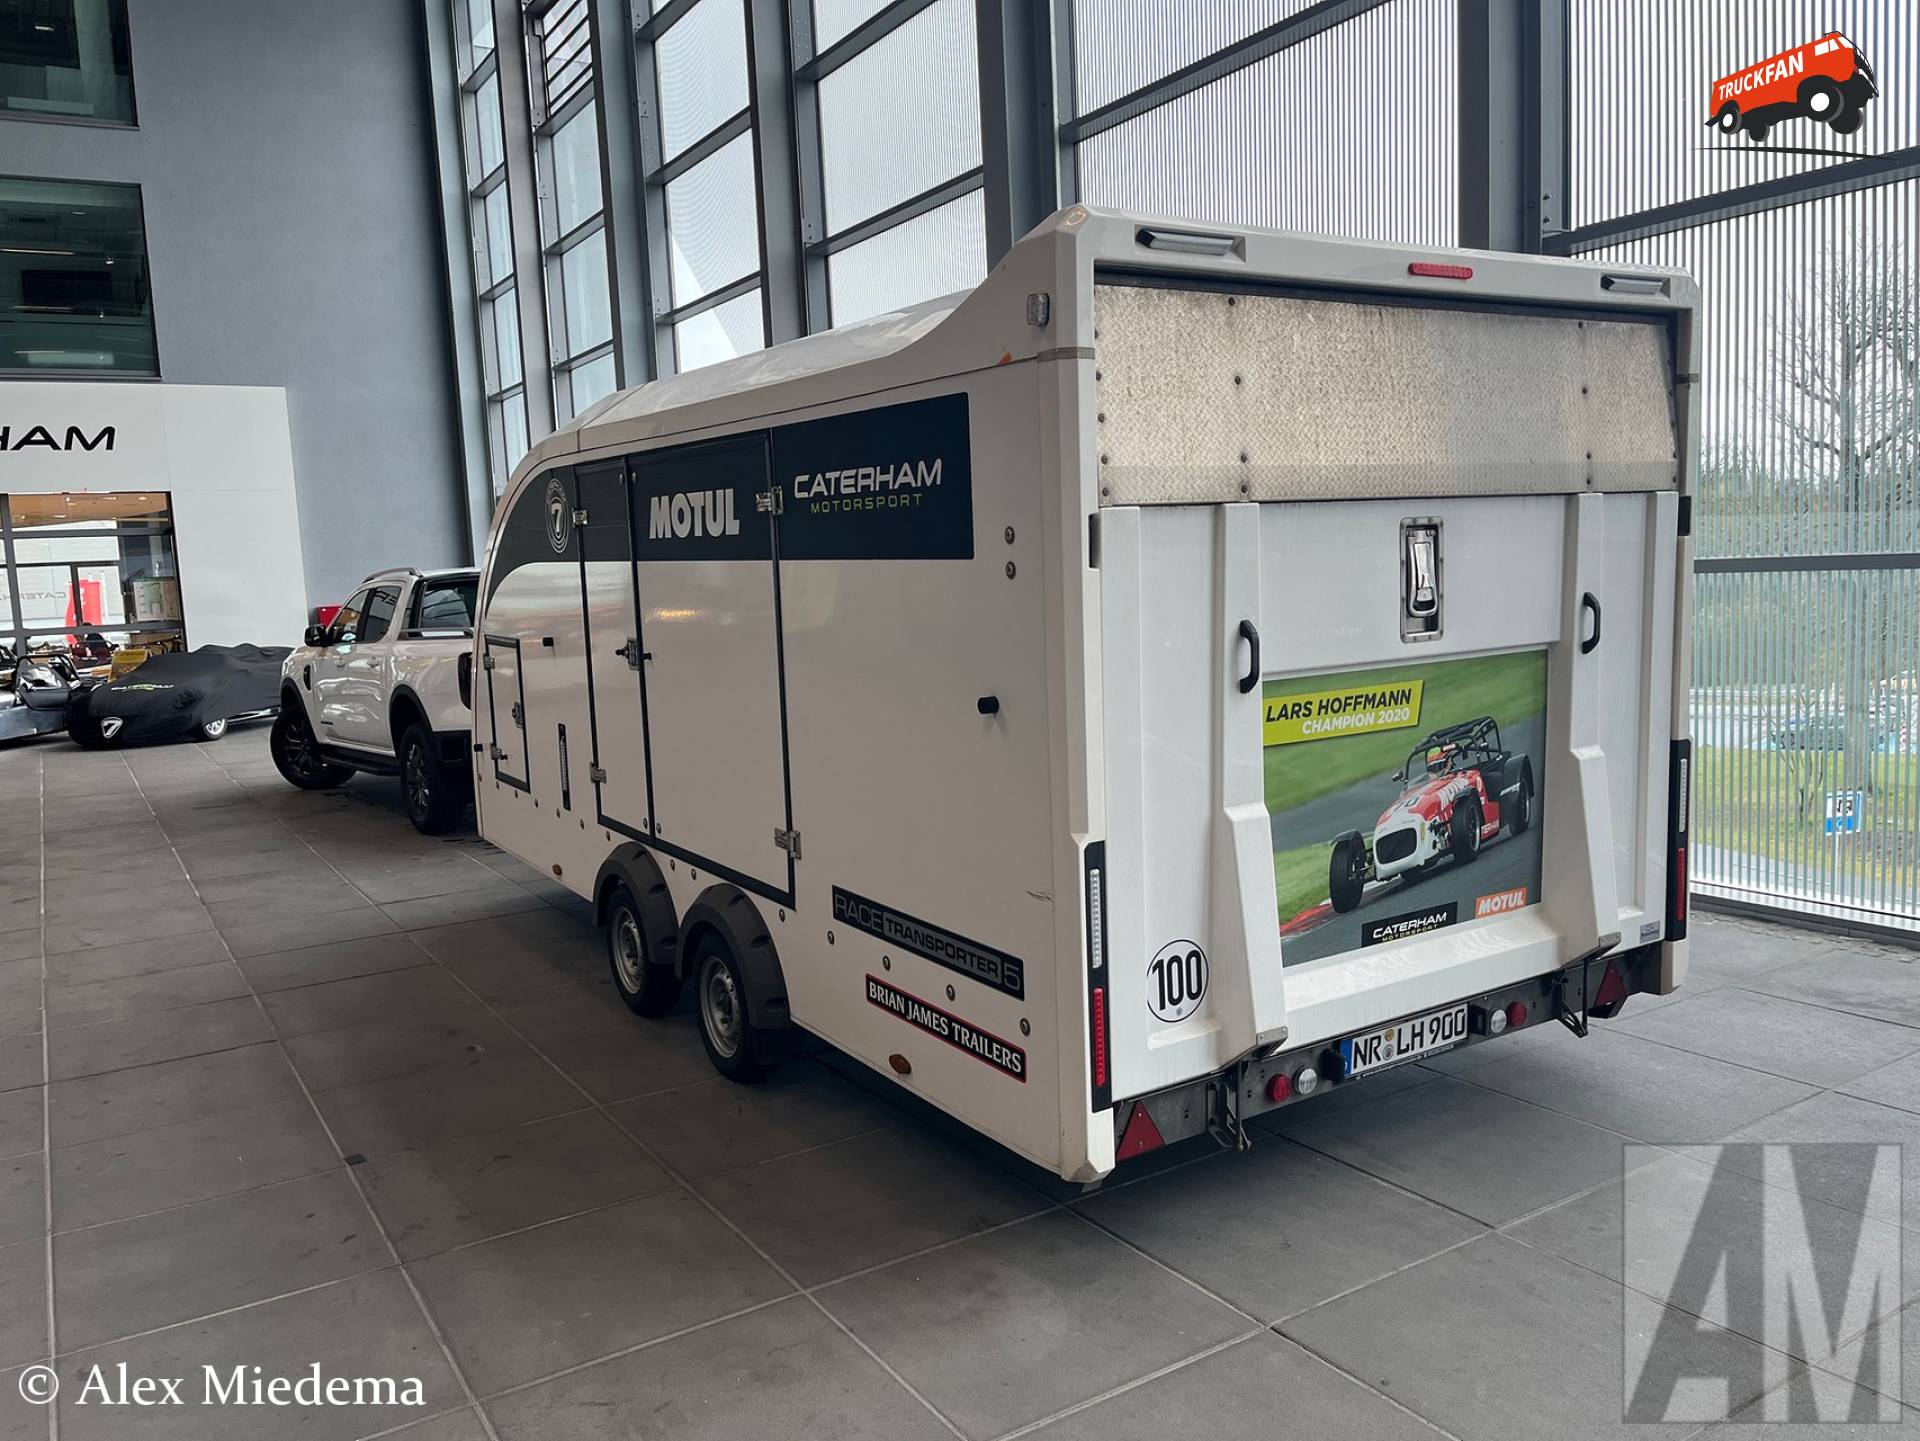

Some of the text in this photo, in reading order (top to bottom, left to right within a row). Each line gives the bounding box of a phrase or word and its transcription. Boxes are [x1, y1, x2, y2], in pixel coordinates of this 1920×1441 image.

[0, 425, 115, 450] AM
[794, 458, 942, 499] CATERHAM
[650, 488, 740, 539] MOTUL
[810, 493, 923, 514] MOTORSPORT
[1266, 688, 1412, 722] LARS HOFFMANN
[1302, 707, 1410, 735] CHAMPION 2020
[1478, 891, 1524, 915] MOTUL
[834, 893, 1020, 991] RACE TRANSPORTER 5
[1372, 911, 1448, 939] CATERHAM
[1381, 924, 1440, 942] MOTORSPORT
[1152, 949, 1202, 1011] 100
[869, 982, 1022, 1074] BRIAN JAMES TRAILERS
[1353, 1035, 1382, 1069] NR
[1397, 1021, 1424, 1055] LH
[1429, 1008, 1466, 1045] 900
